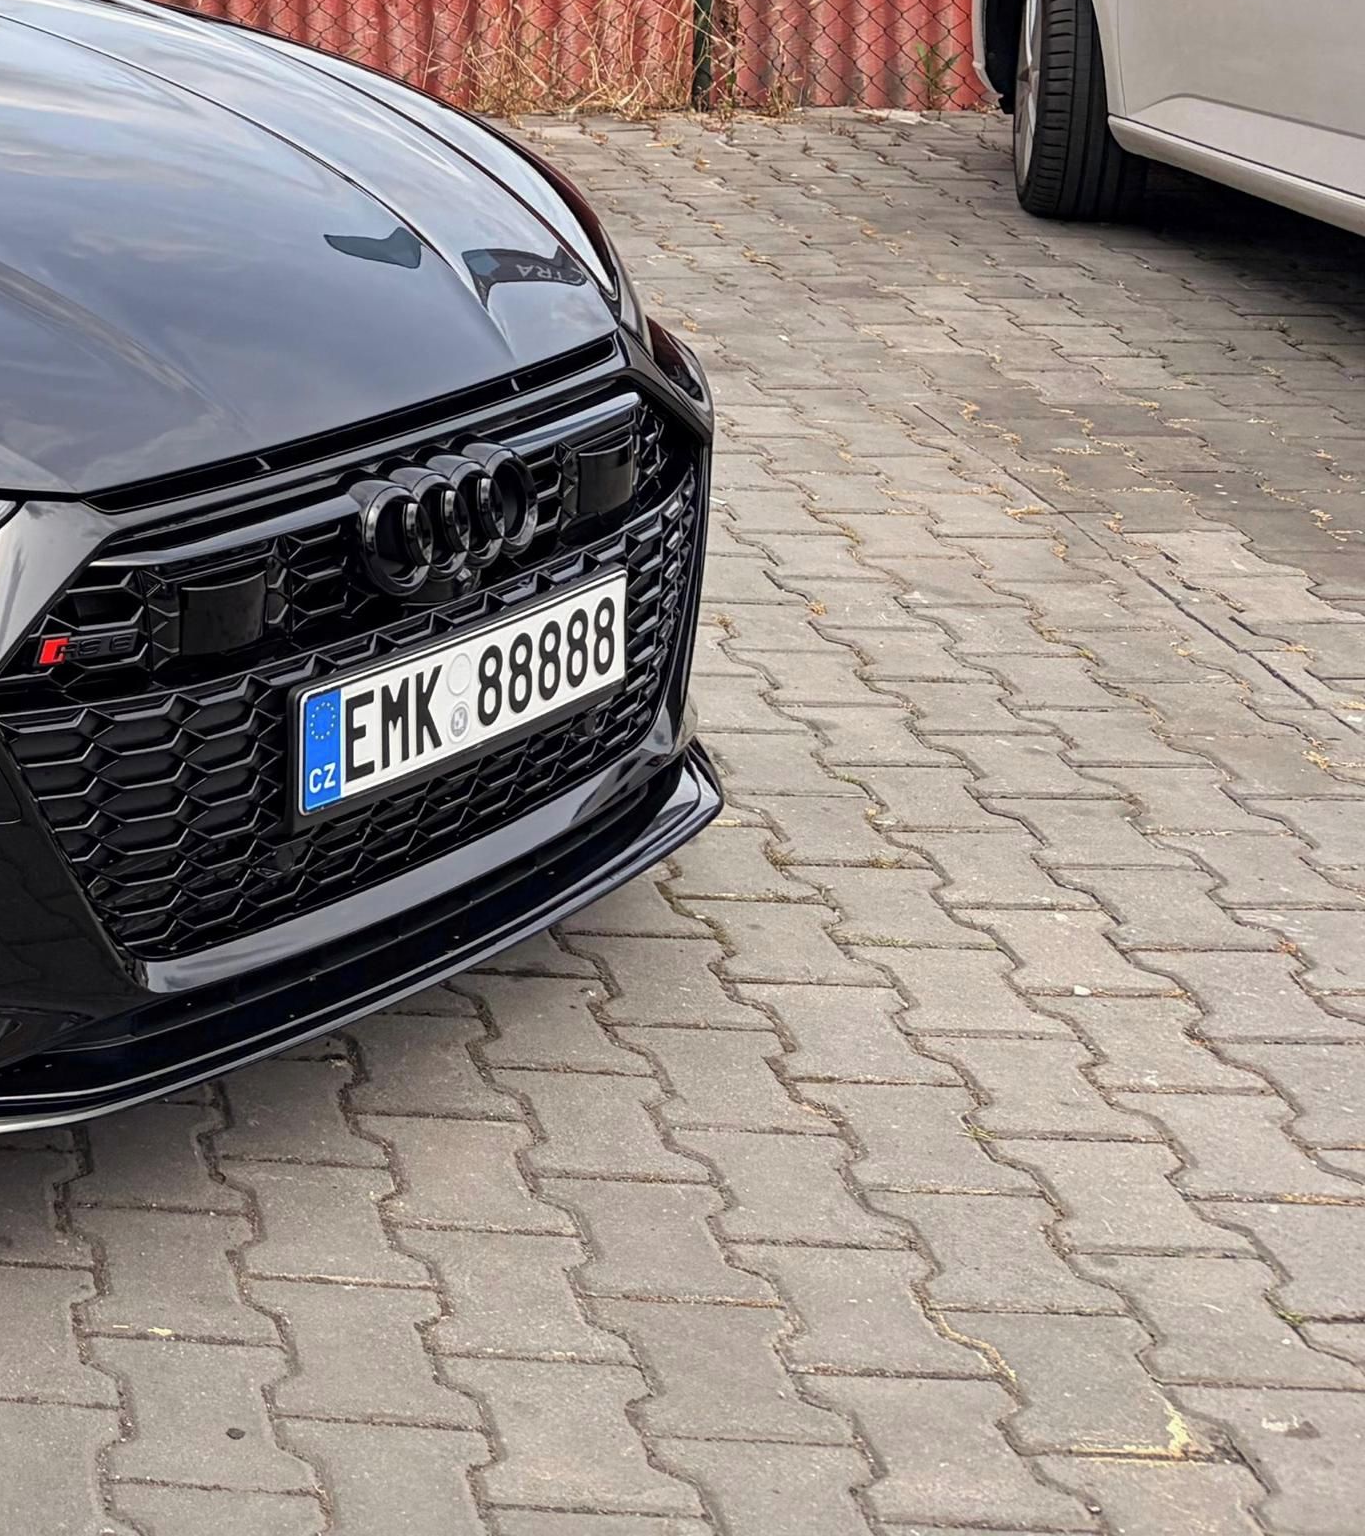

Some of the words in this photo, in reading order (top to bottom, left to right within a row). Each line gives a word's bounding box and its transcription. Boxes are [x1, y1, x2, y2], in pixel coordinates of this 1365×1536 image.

[344, 664, 443, 783] EMK
[477, 596, 615, 726] 88888
[308, 762, 336, 794] CZ
